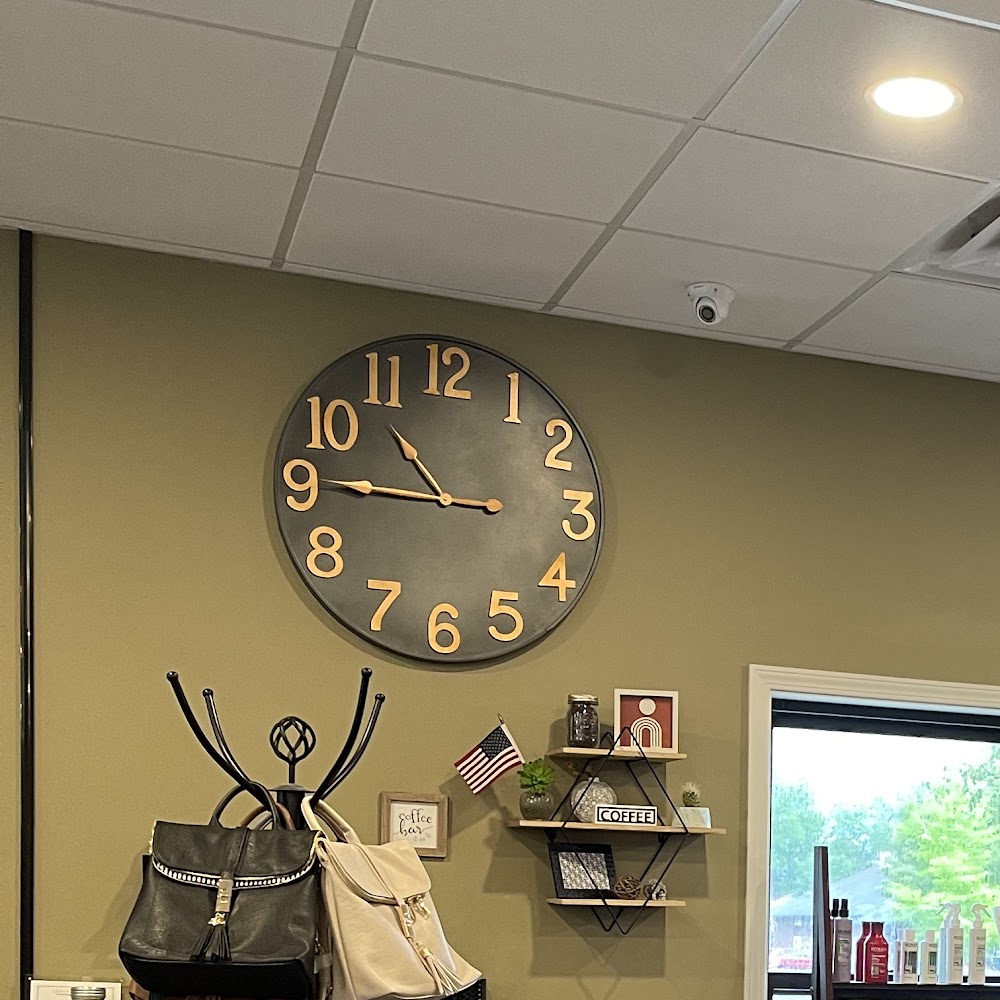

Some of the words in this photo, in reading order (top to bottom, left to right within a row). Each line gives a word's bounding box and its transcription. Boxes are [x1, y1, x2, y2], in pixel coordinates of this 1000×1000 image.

[363, 352, 403, 408] 11
[422, 343, 472, 400] 12
[503, 371, 522, 424] 1
[305, 396, 359, 451] 10
[544, 418, 573, 471] 2
[282, 458, 319, 512] 9
[561, 489, 596, 541] 3
[306, 525, 344, 579] 8
[537, 551, 577, 602] 4
[366, 579, 402, 632] 7
[427, 602, 461, 654] 6
[487, 590, 524, 642] 5
[396, 818, 428, 837] bar
[398, 808, 433, 824] coffee
[600, 810, 652, 823] COFFEE
